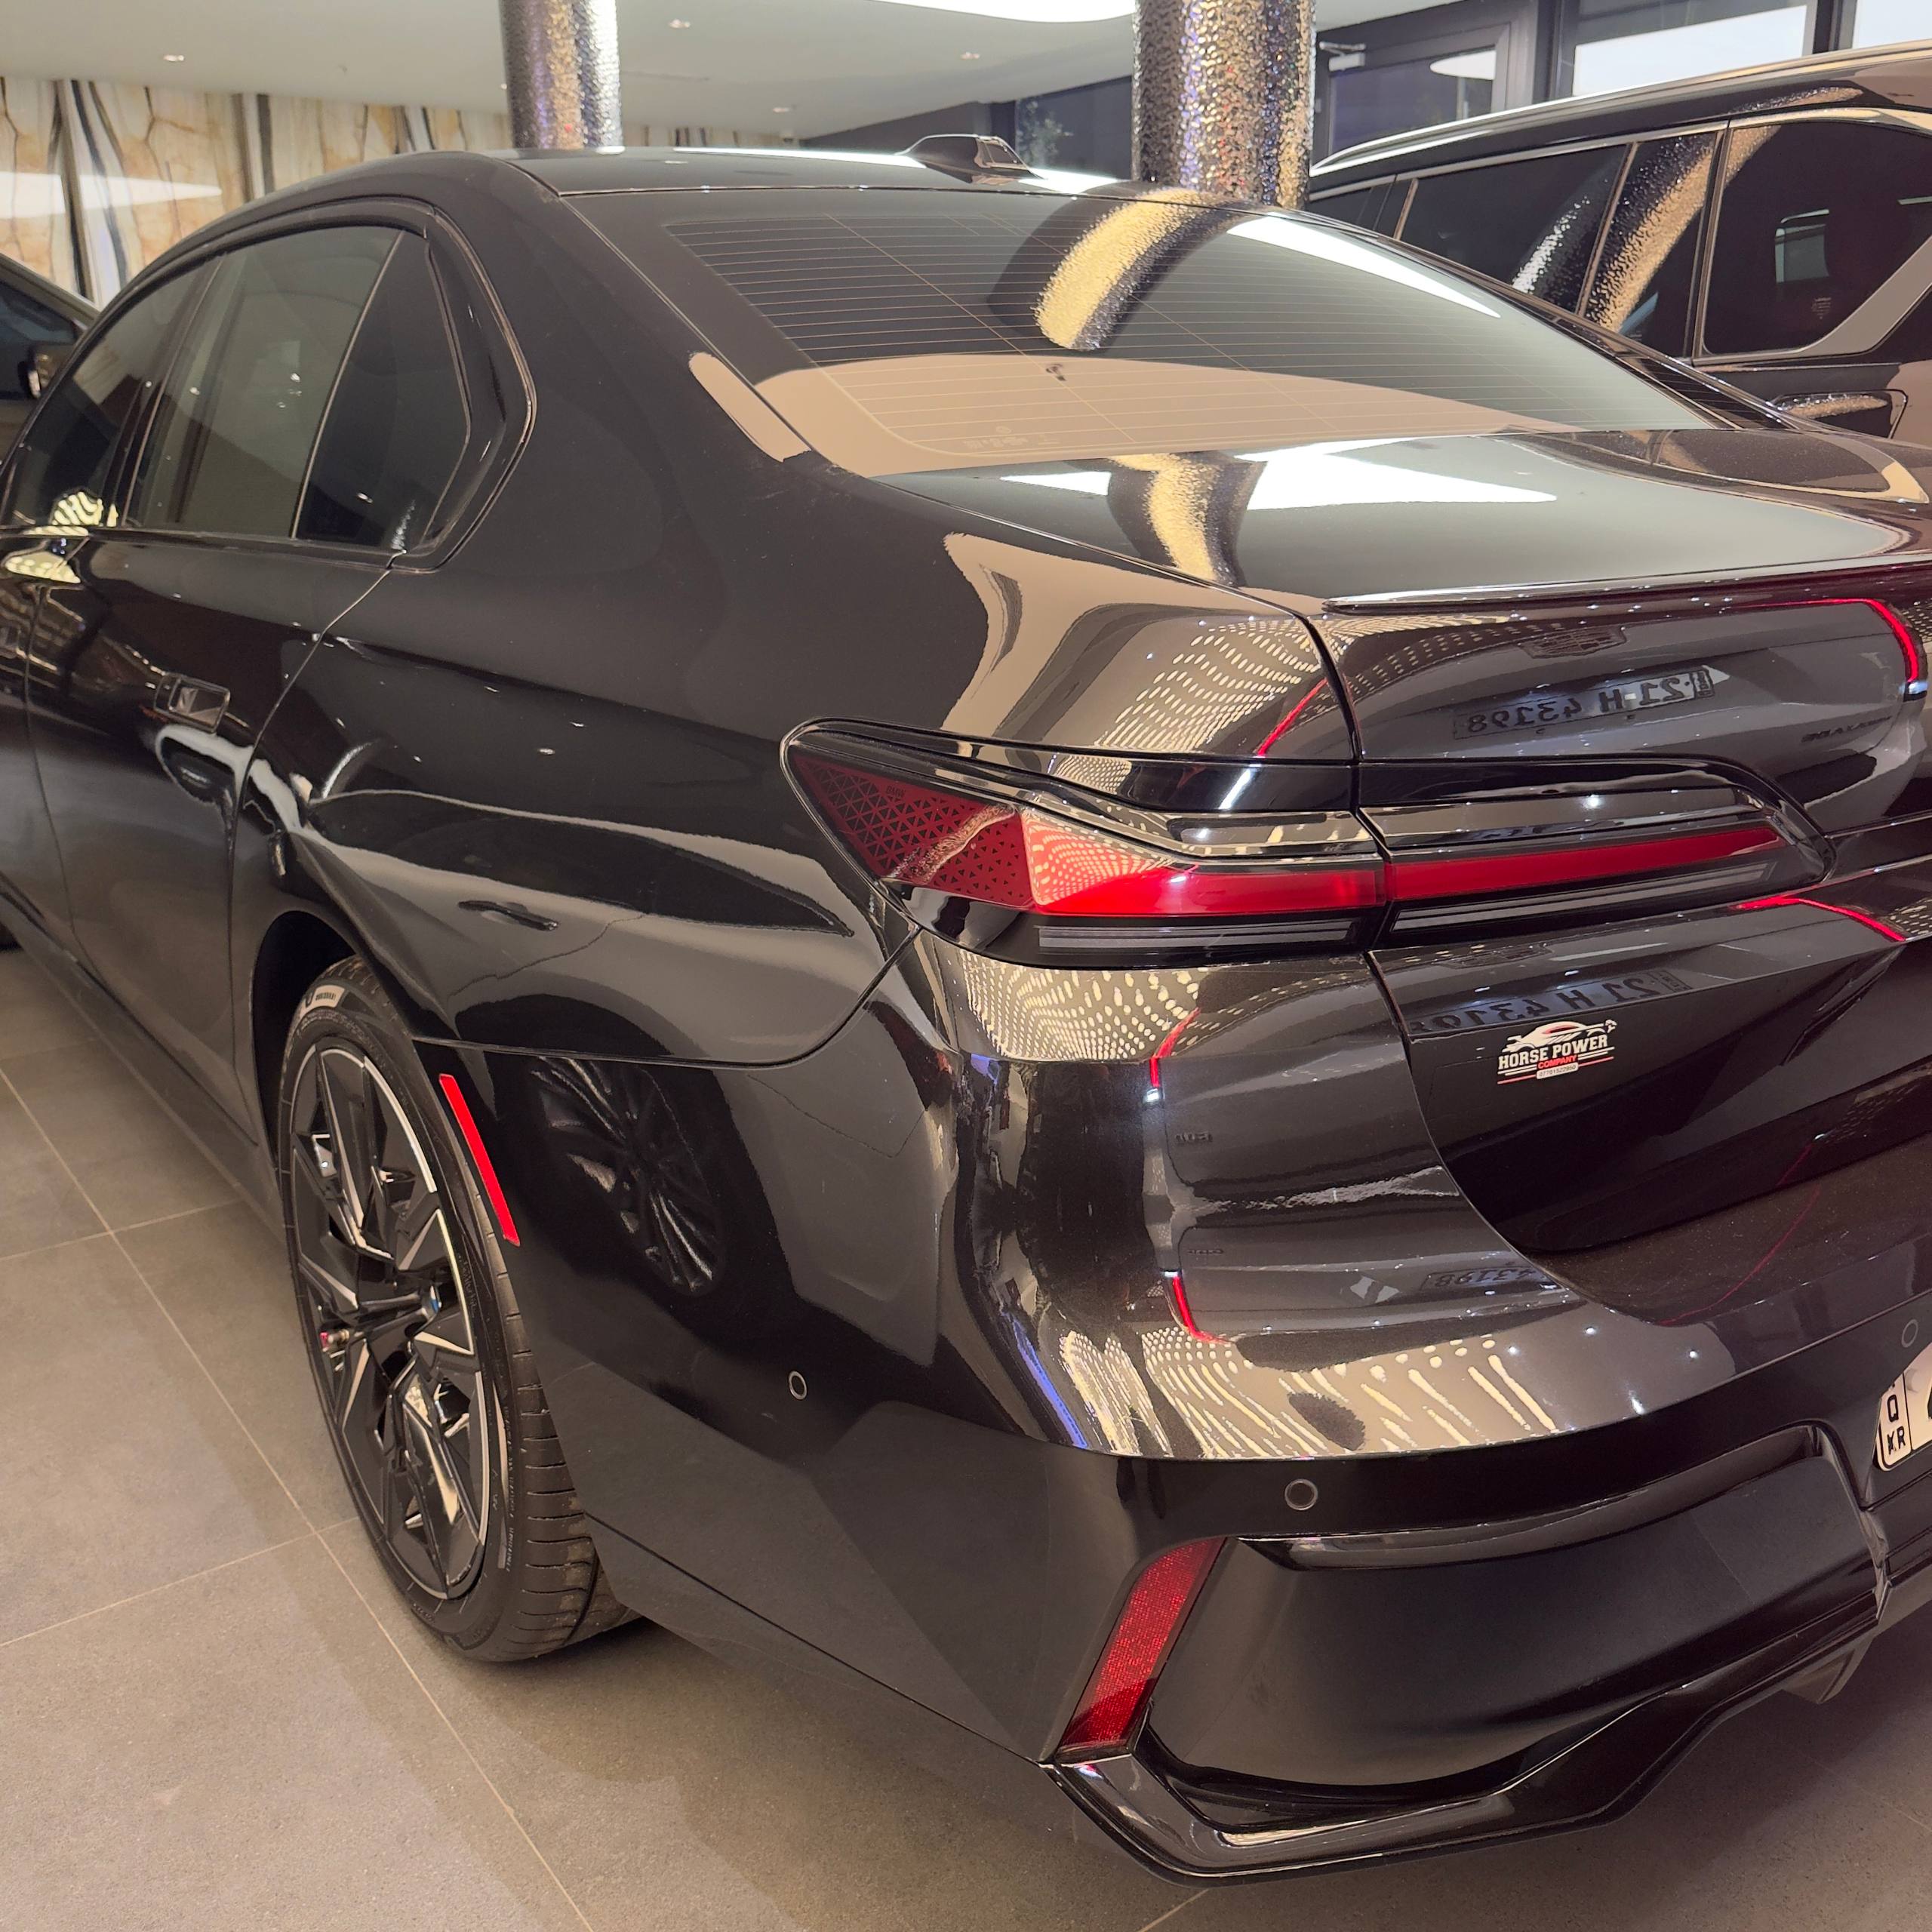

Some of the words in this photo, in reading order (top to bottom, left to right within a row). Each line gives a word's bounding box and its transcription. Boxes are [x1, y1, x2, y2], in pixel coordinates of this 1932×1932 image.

[1498, 1047, 1549, 1070] HORSE
[1552, 1034, 1608, 1058] POWER
[1537, 1054, 1577, 1069] COMPANY
[1887, 1426, 1906, 1455] KR
